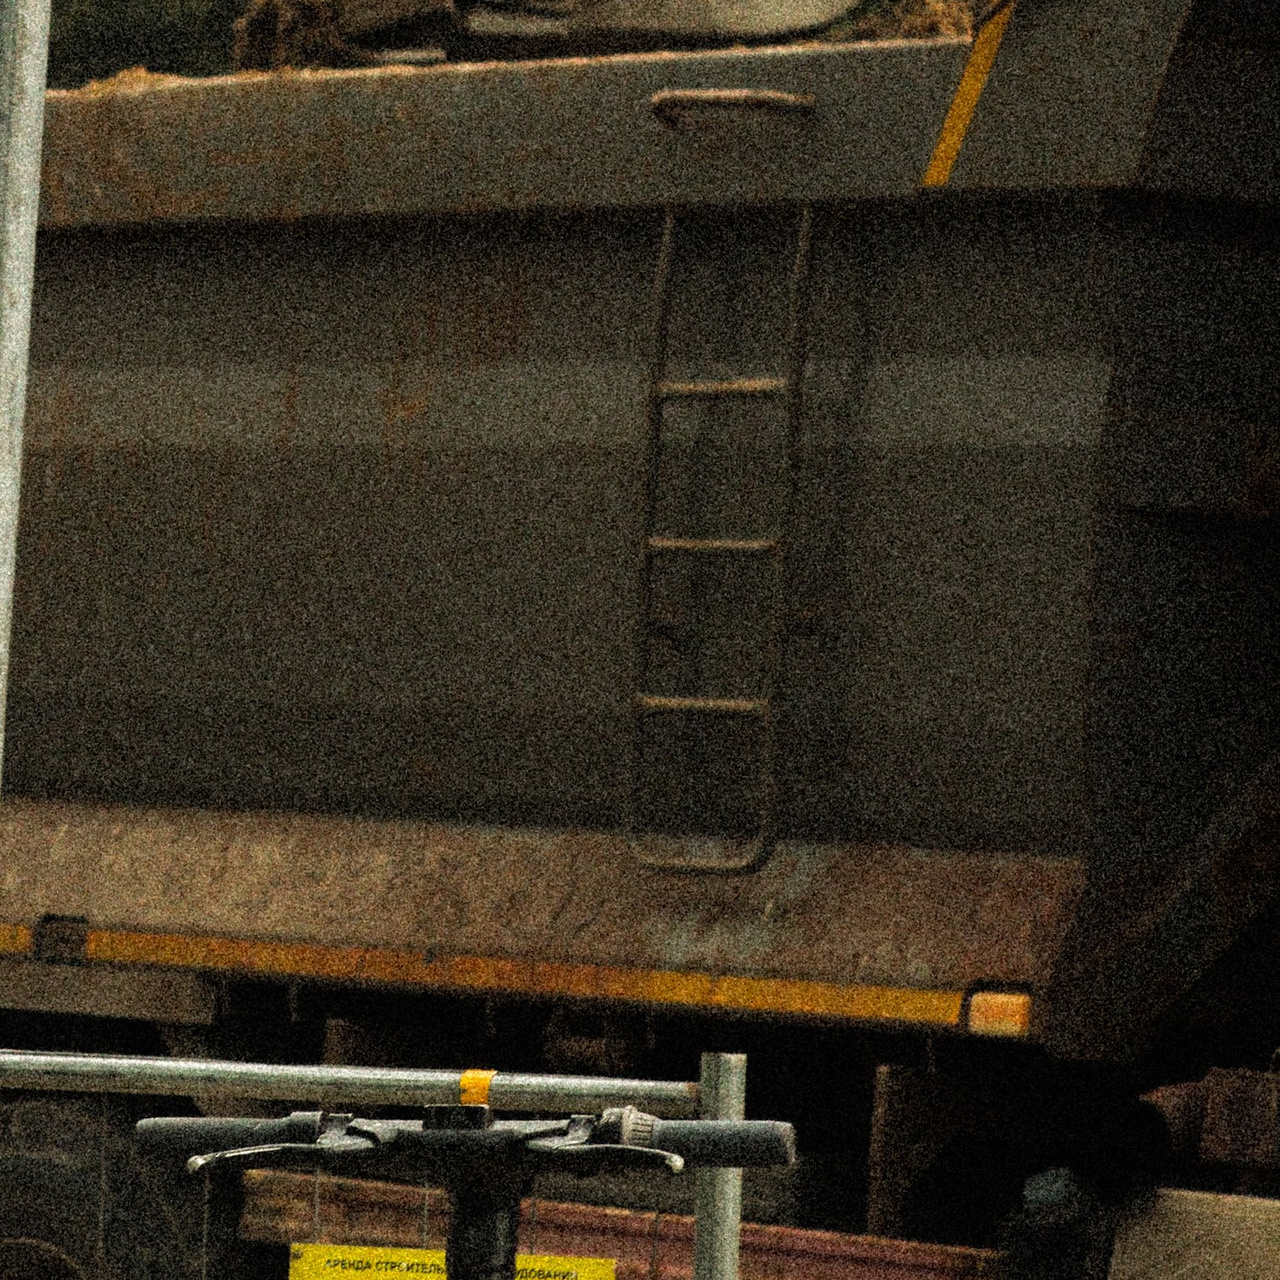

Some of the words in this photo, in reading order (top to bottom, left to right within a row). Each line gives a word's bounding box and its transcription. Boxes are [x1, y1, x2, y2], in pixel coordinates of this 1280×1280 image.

[325, 1258, 371, 1272] АРЕНДА
[375, 1260, 446, 1274] СТРОИТЕЛЬ
[515, 1268, 578, 1280] УДОВАНИЯ
